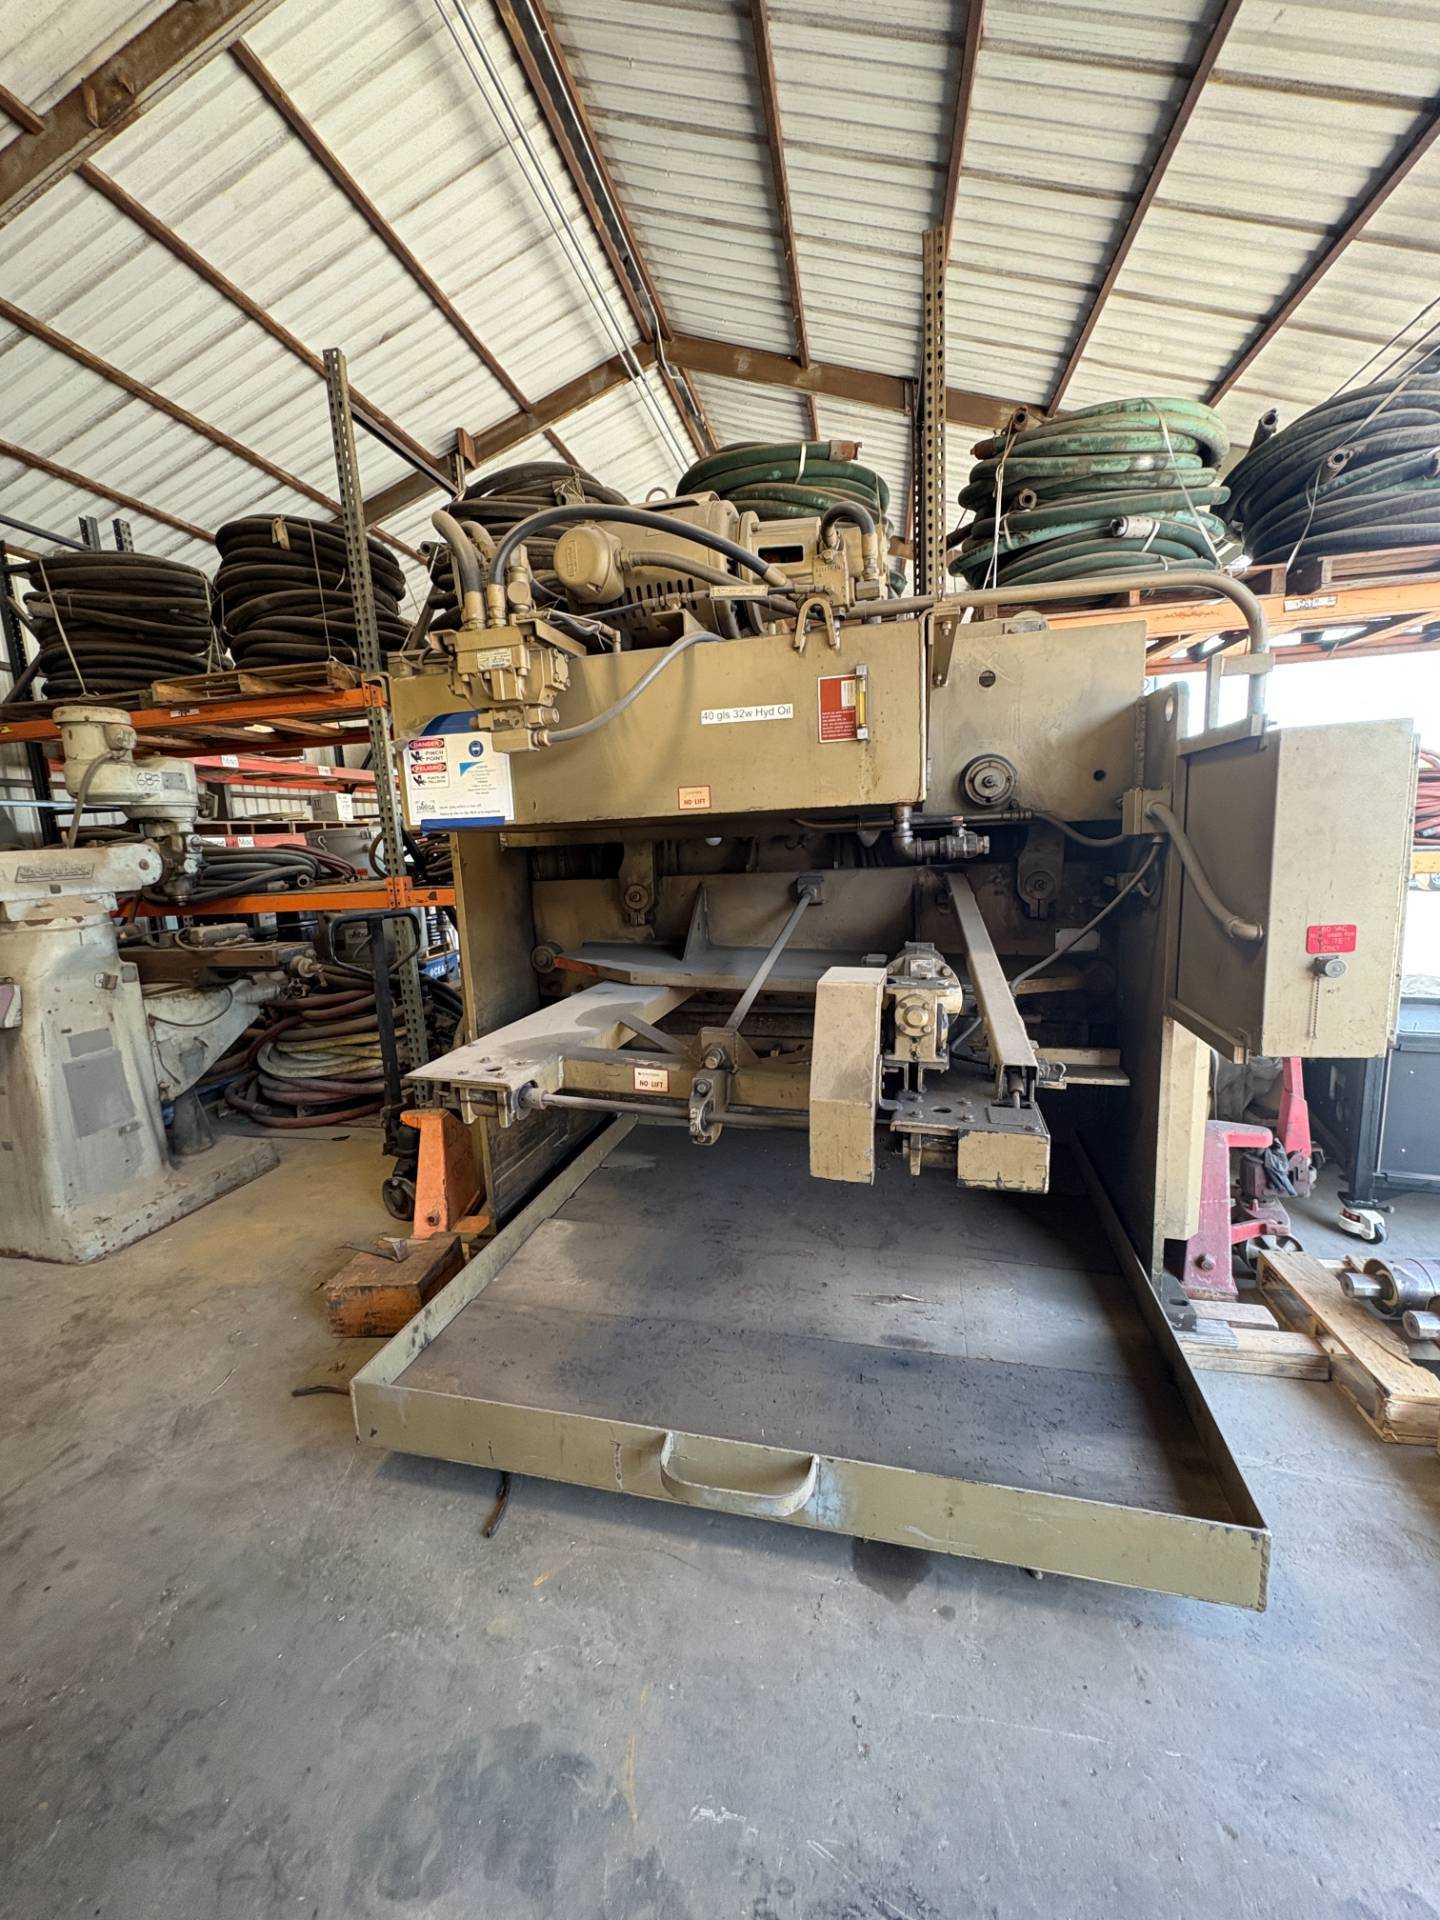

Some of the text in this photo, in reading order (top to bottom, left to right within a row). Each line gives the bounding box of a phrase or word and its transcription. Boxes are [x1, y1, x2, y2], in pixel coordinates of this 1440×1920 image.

[702, 705, 791, 721] 40 gls 32w Hyd Oil
[413, 740, 442, 748] DANGER
[414, 764, 443, 772] PELIGRO
